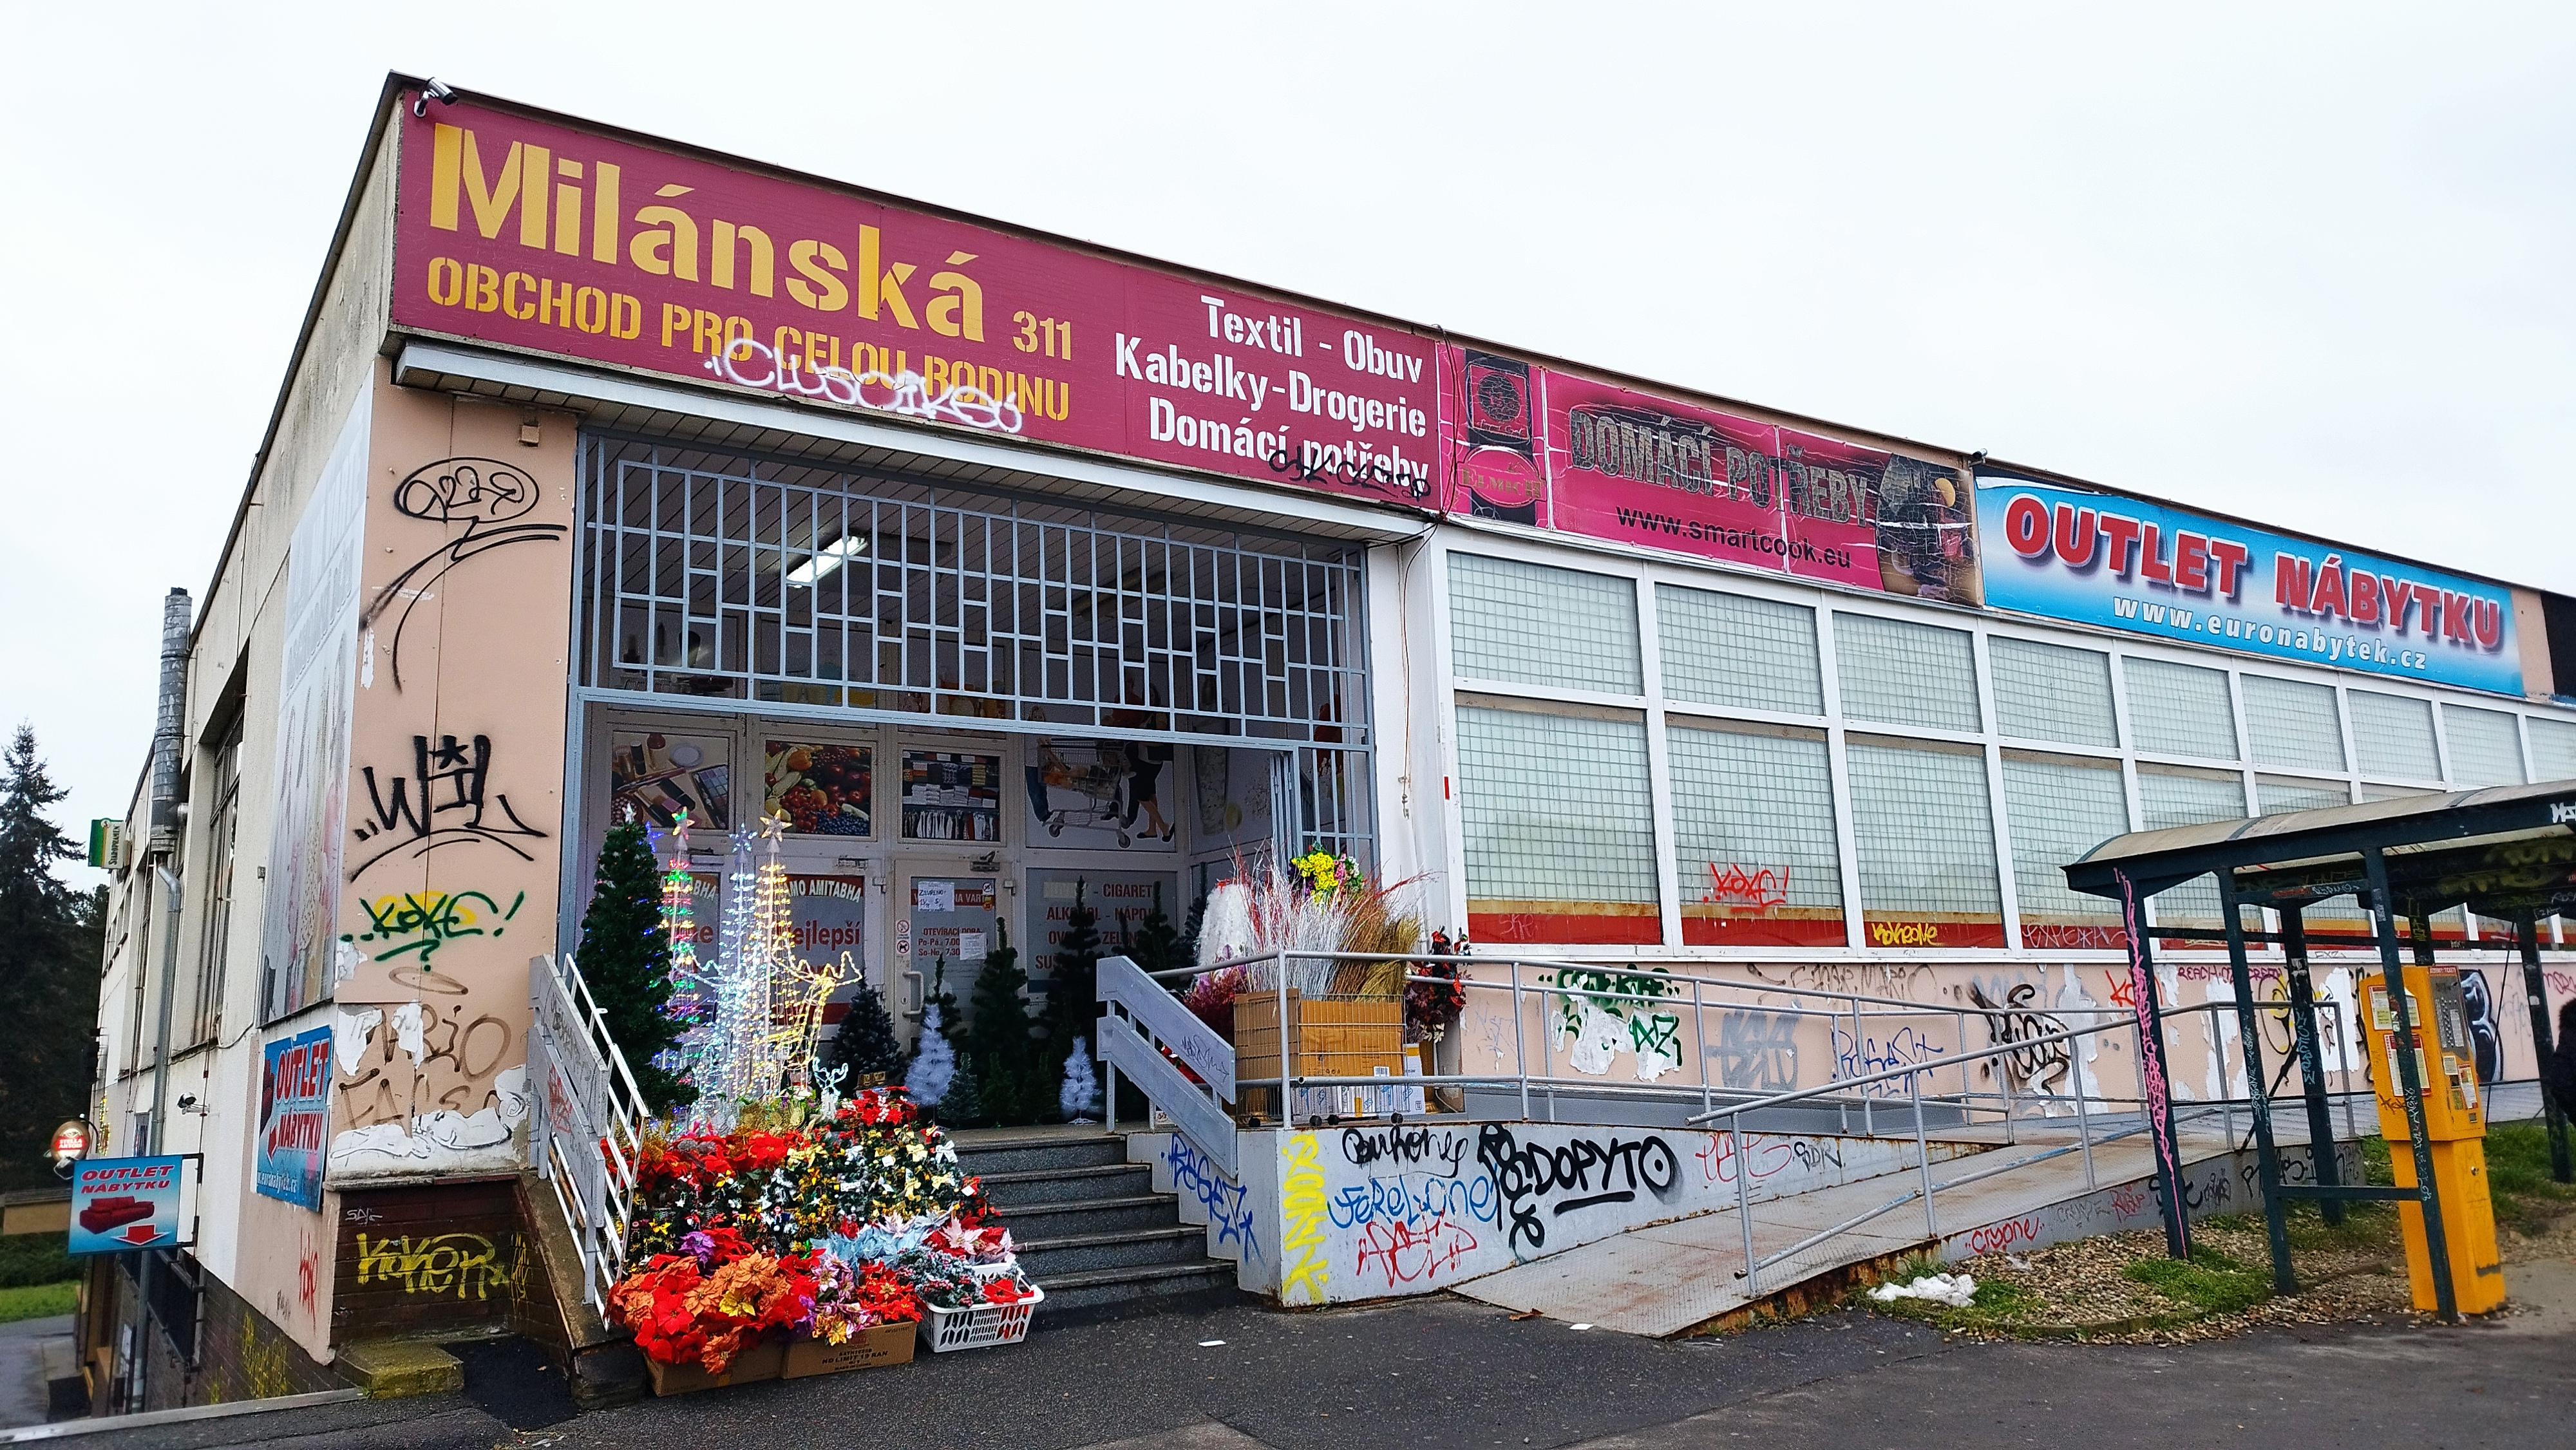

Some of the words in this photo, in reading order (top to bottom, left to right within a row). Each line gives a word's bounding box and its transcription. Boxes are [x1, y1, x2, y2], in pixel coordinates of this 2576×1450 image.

[430, 122, 985, 343] Milánská
[427, 257, 641, 340] OBCHOD
[661, 303, 753, 362] PRO
[774, 325, 906, 393] CELOU
[923, 355, 1070, 422] RODINU
[1012, 311, 1072, 361] 311
[1200, 295, 1303, 358] Textil
[1343, 330, 1423, 384] Obuv
[1150, 397, 1289, 464] Domácí
[1303, 440, 1430, 499] potřeby
[1569, 408, 1714, 497] DOMÁCÍ
[1728, 443, 1868, 529] POTŘEBY
[1616, 506, 1852, 570] www.smartcook.eu
[2003, 493, 2249, 599] OUTLET
[2274, 552, 2501, 648] NÁBYTKU
[2113, 594, 2429, 671] www.euronabytek.cz
[809, 879, 863, 903] AMITABHA
[923, 926, 960, 936] OTEVÍRACÍ
[276, 1041, 330, 1104] OUTLET
[81, 1165, 175, 1181] OUTLET
[81, 1179, 171, 1194] NÁBYTKU
